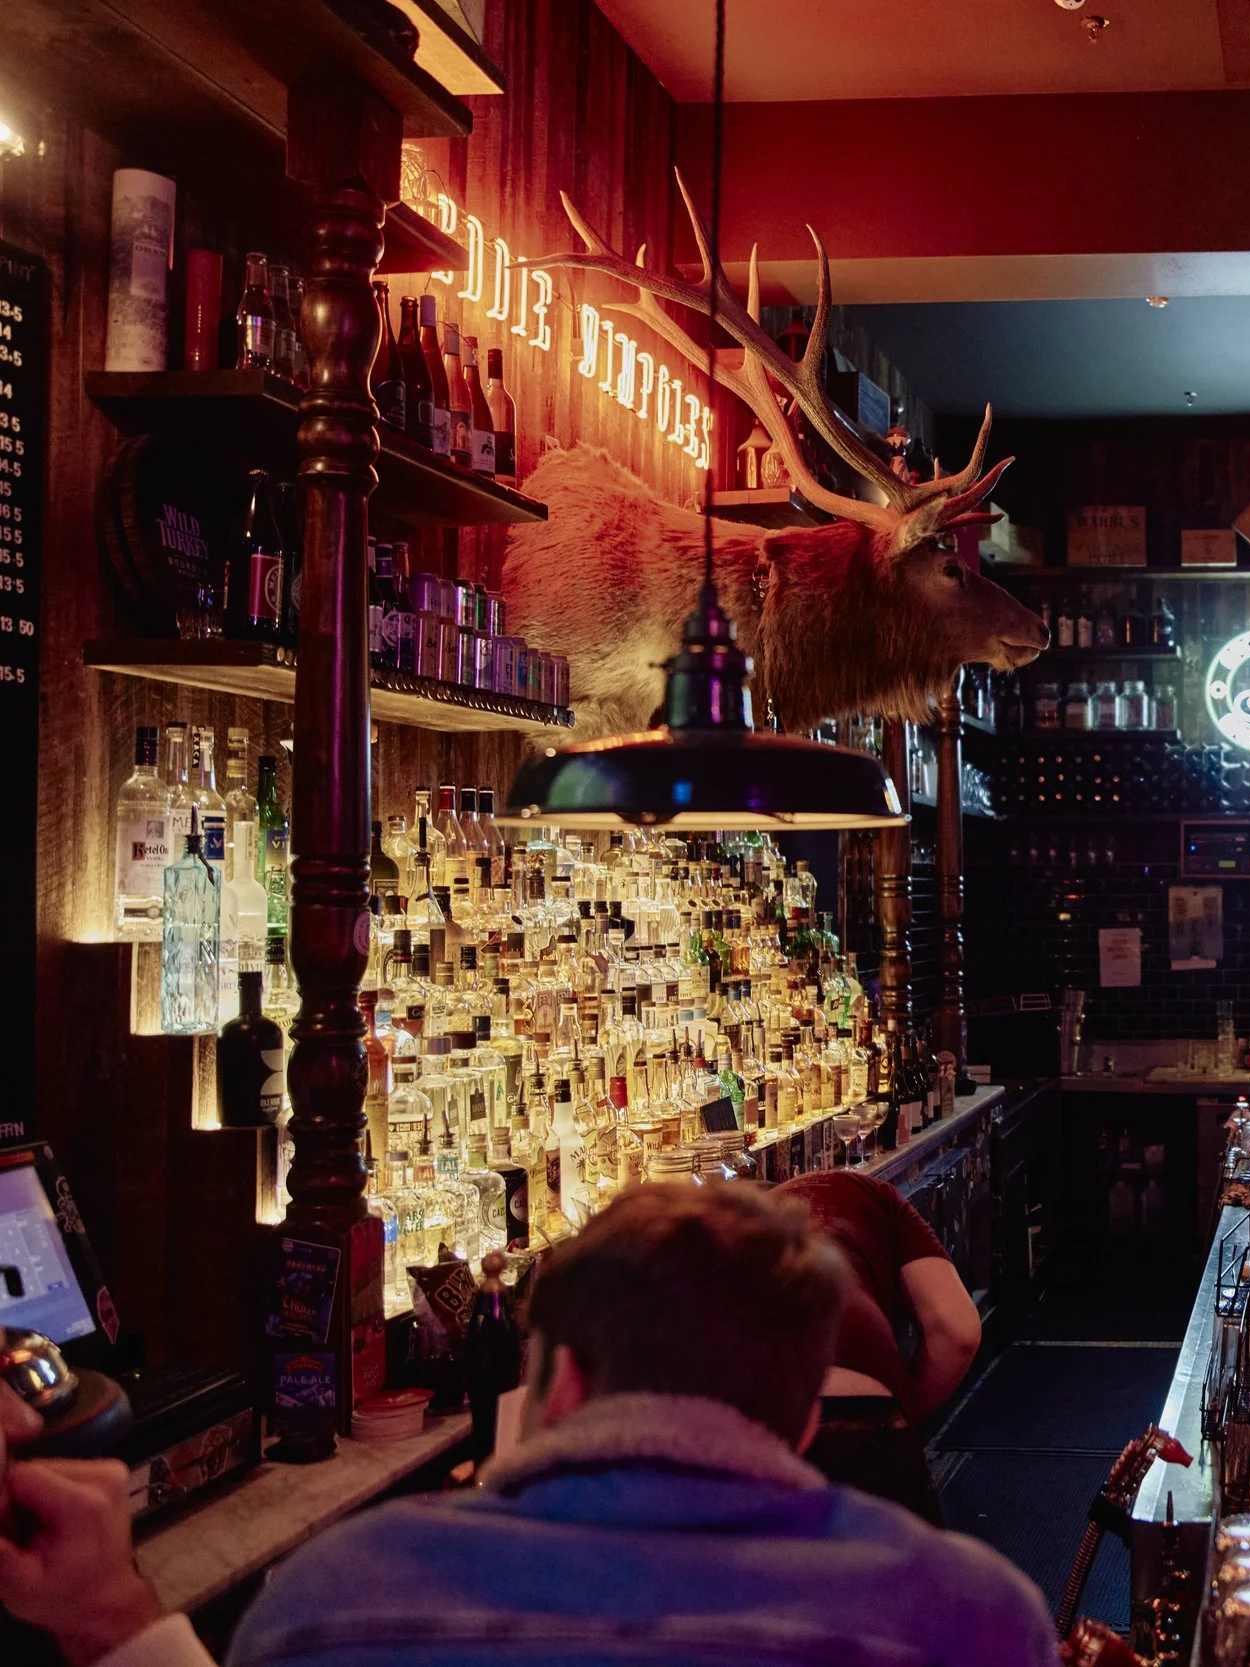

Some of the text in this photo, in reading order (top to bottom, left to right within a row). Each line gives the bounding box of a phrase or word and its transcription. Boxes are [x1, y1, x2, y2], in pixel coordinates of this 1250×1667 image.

[0, 301, 23, 322] 3.5
[0, 345, 23, 367] 3.5
[162, 504, 200, 536] WILD
[155, 518, 209, 560] TURKEY
[281, 1374, 308, 1386] PALE
